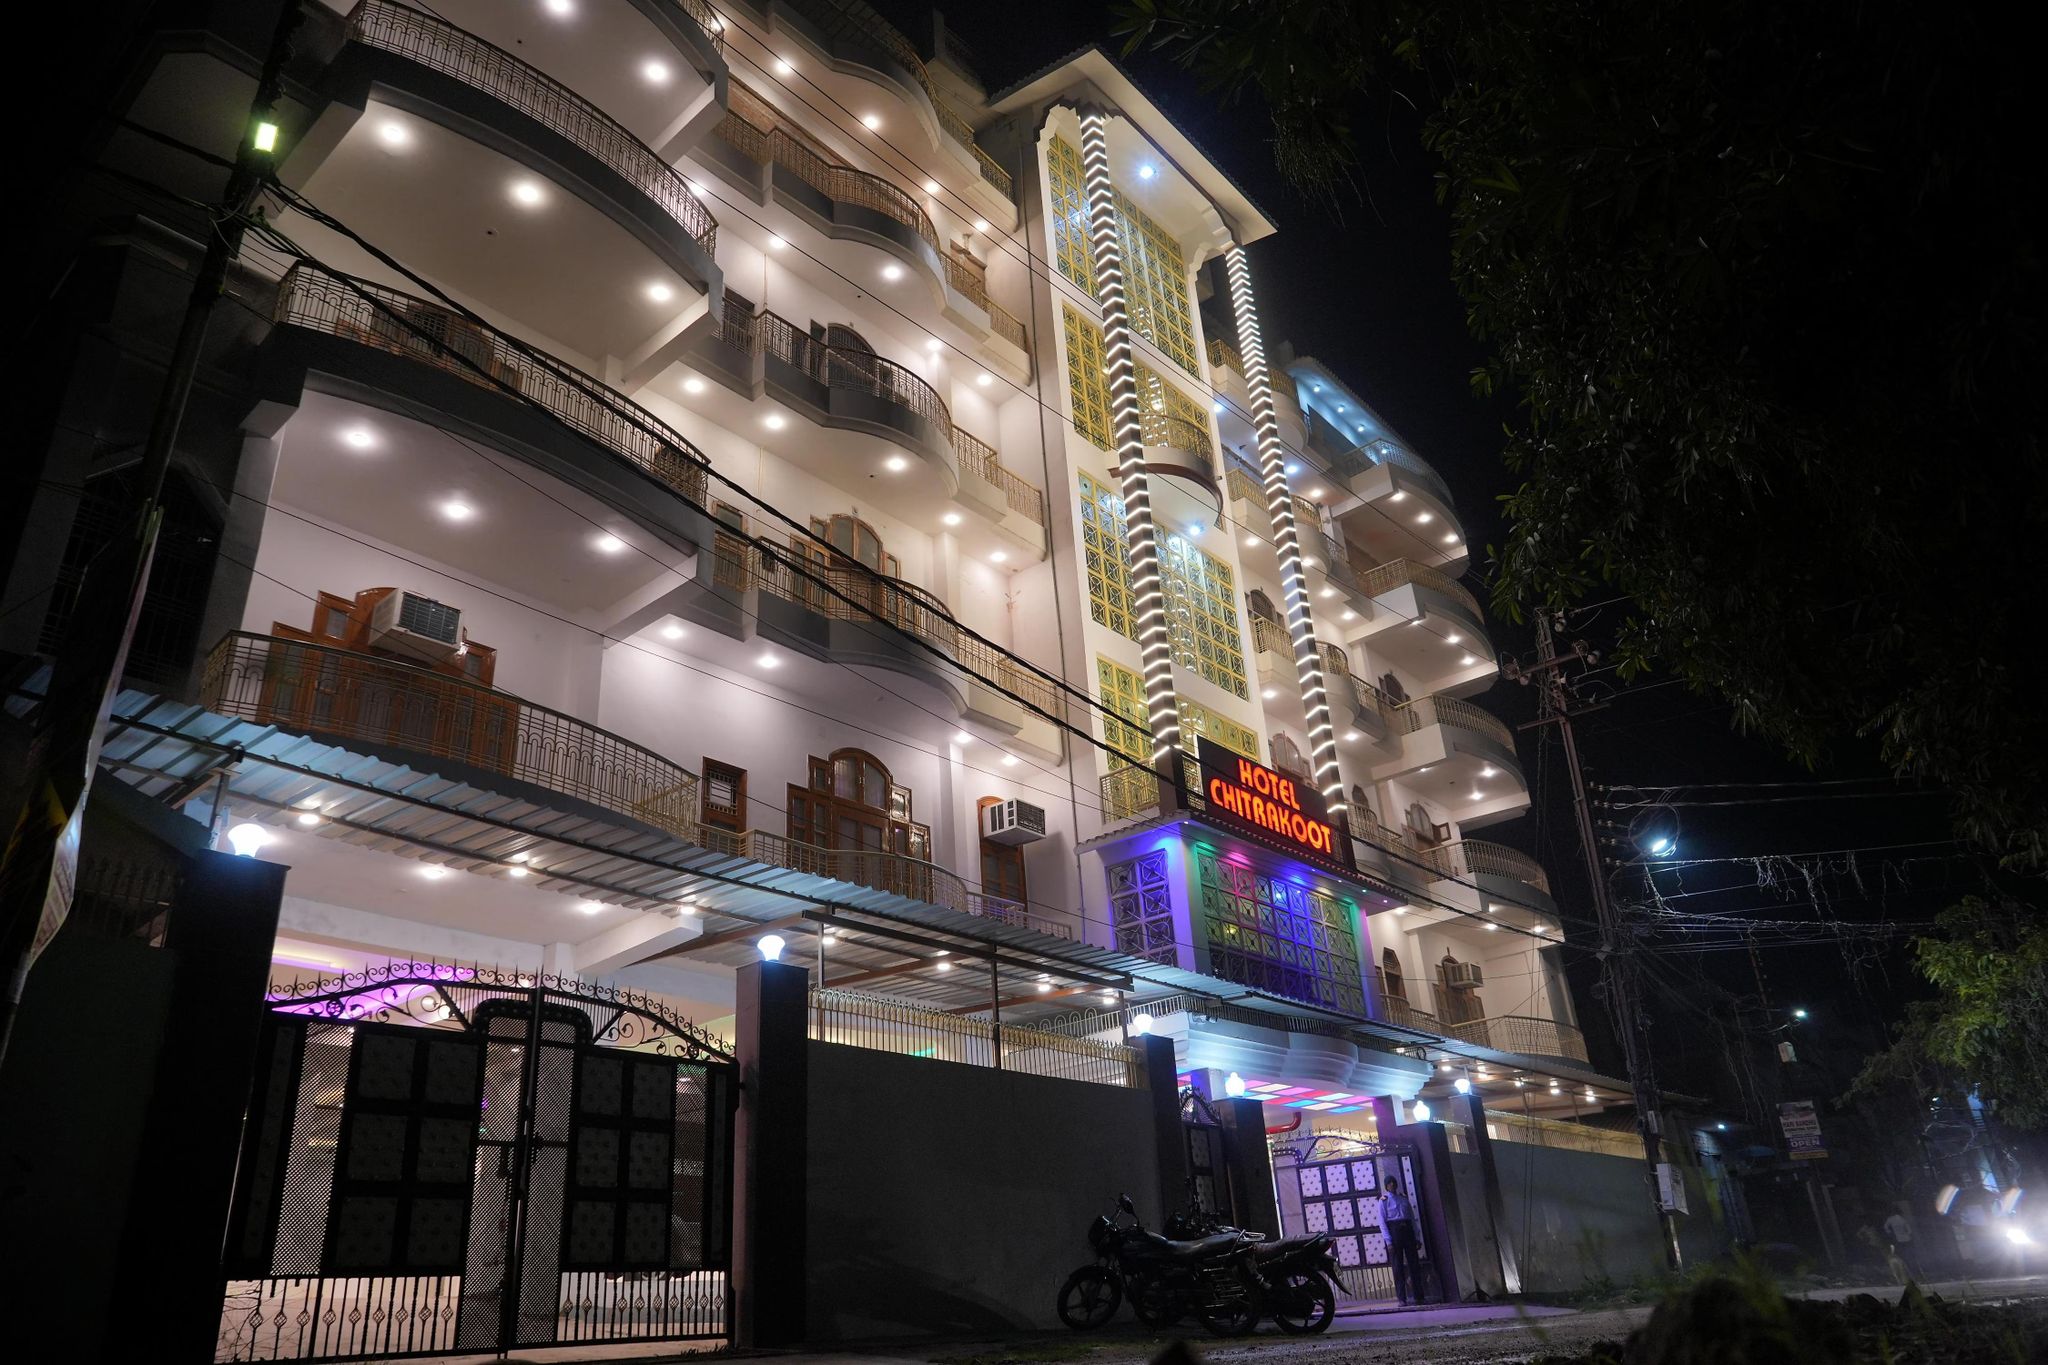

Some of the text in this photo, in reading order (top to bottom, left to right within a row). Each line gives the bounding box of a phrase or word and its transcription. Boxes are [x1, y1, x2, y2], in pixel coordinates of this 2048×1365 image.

[1238, 758, 1301, 811] HOTEL
[1210, 778, 1332, 854] CHITRAKOOT
[1790, 1137, 1820, 1148] OPEN
